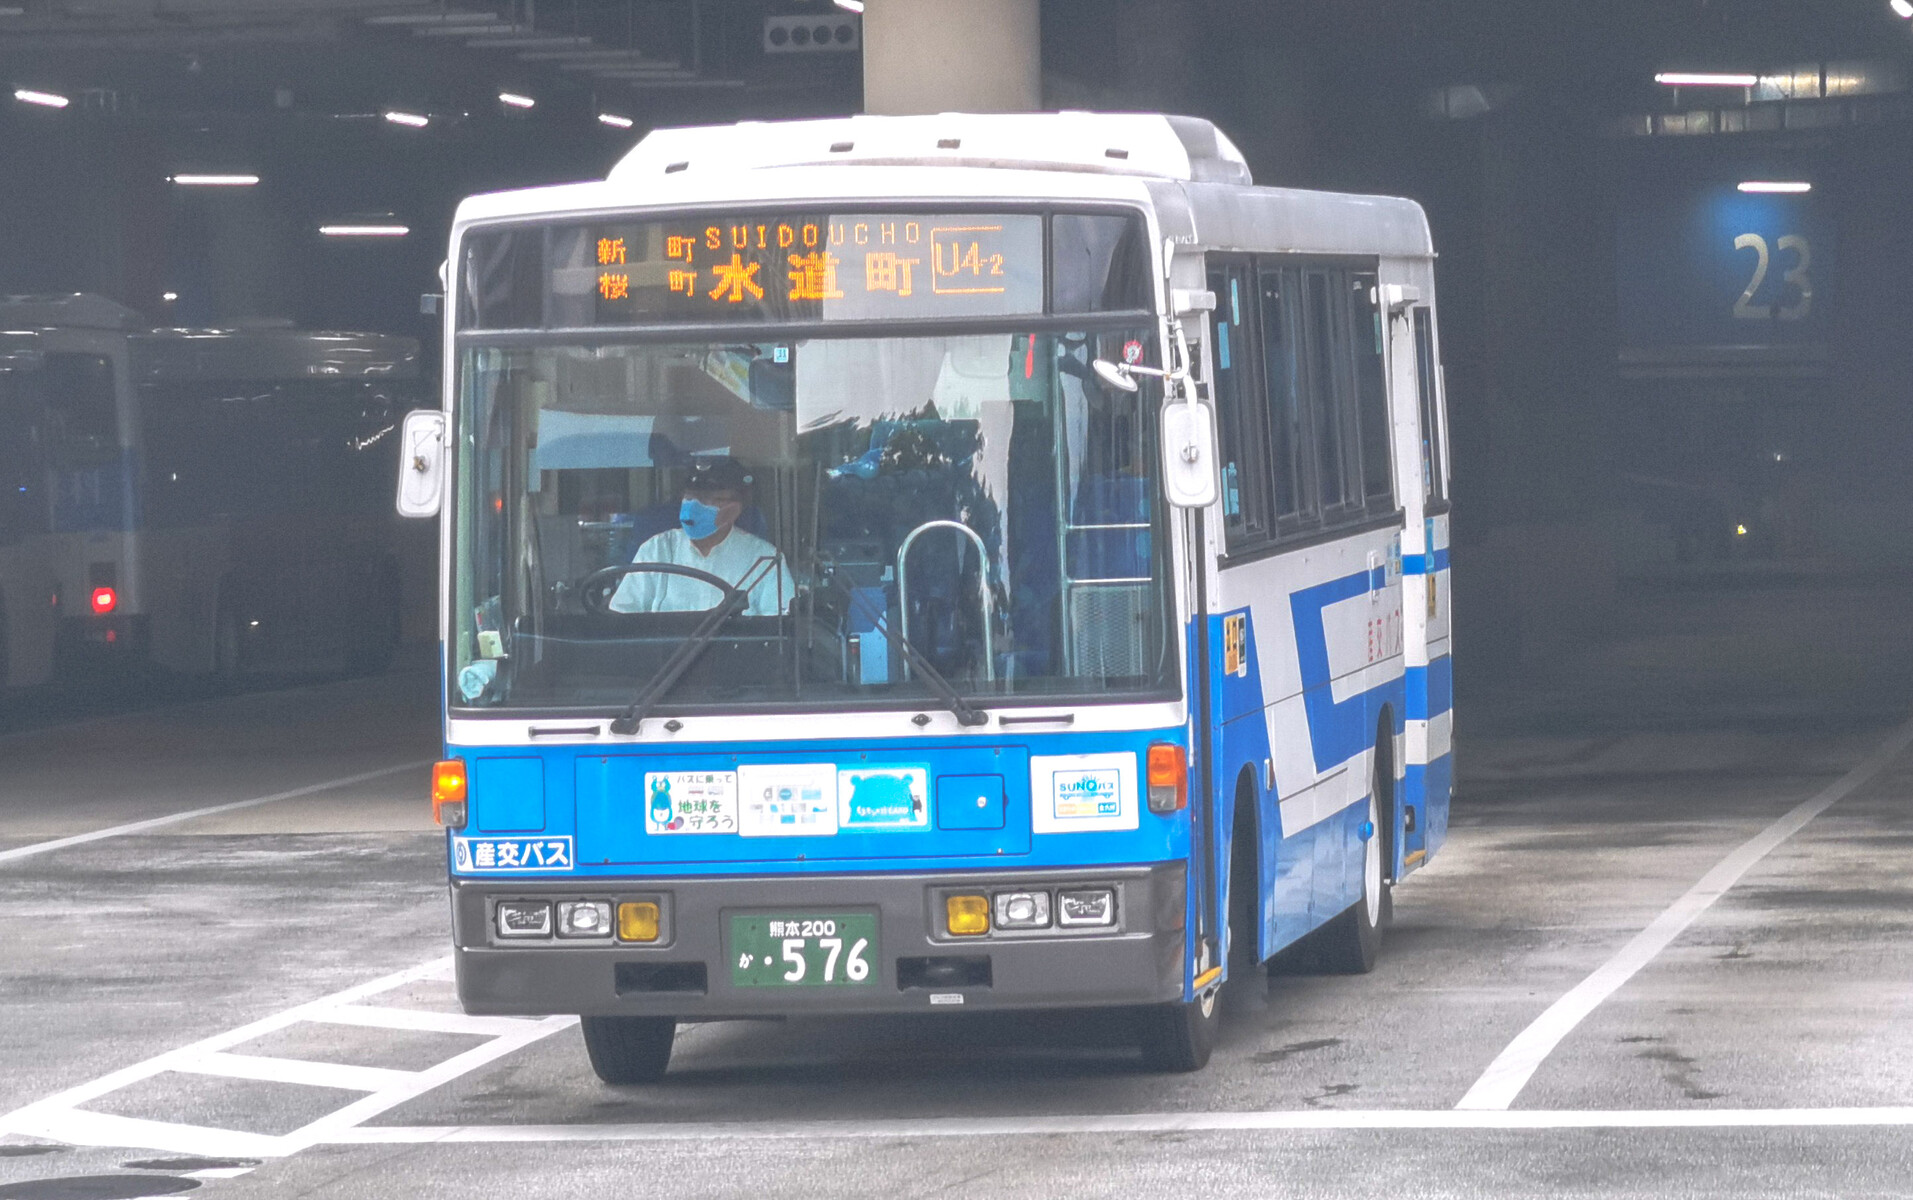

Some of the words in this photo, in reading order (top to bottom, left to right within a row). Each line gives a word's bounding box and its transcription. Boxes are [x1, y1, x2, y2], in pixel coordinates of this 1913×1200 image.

[704, 223, 922, 249] SUIDOUCHO
[708, 252, 919, 301] 水道町
[1733, 232, 1813, 318] 23
[678, 798, 722, 814] 地球を
[689, 814, 734, 830] 守ろう
[475, 841, 569, 867] 産交バス
[738, 953, 754, 969] か
